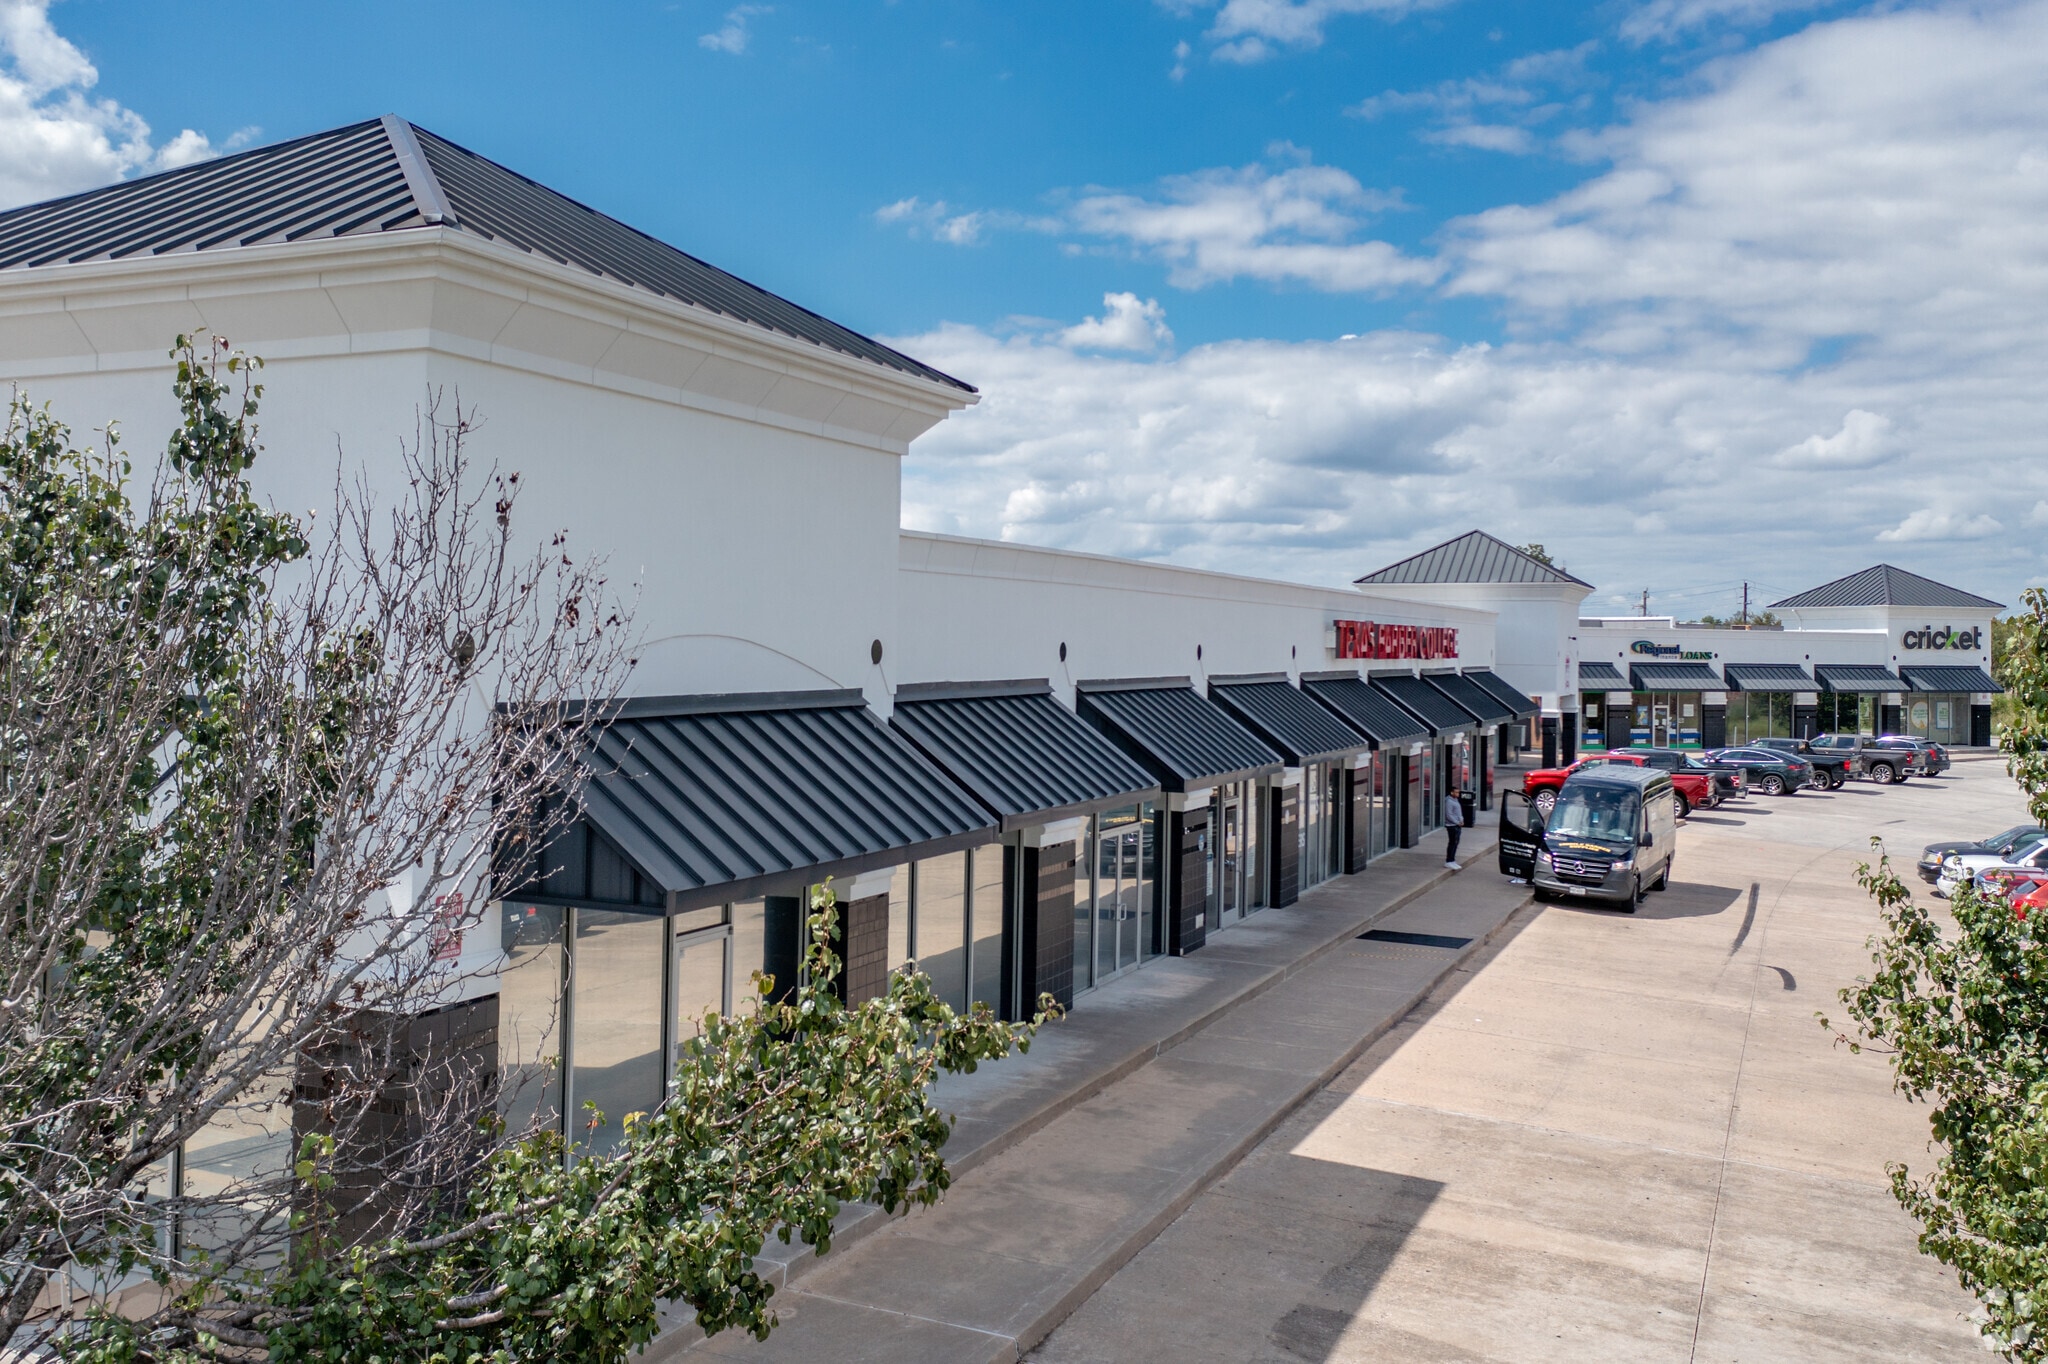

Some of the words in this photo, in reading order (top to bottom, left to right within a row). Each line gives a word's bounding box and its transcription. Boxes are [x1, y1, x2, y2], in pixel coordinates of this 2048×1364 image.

[1334, 620, 1374, 658] TEXAS
[1376, 624, 1417, 659] BARBER
[1419, 627, 1459, 659] COLLEGE
[1903, 625, 1982, 649] cricket
[1639, 644, 1680, 657] Regional
[1680, 651, 1712, 659] LOANS
